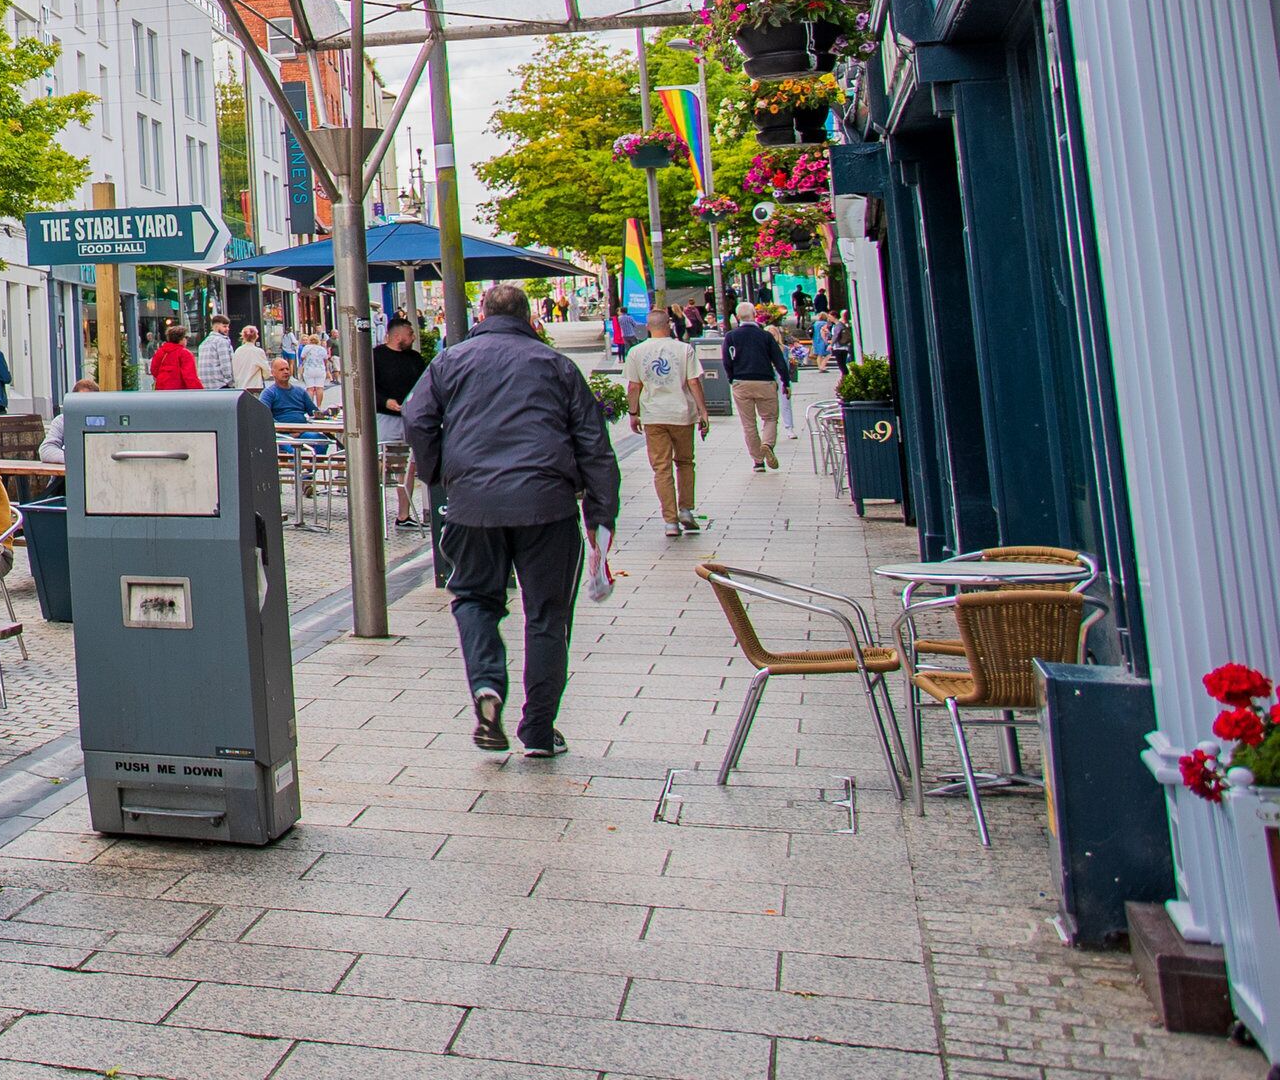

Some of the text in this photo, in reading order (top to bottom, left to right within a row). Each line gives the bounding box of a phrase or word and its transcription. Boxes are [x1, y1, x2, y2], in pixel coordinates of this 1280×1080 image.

[40, 214, 183, 242] THE STABLE YARD.
[81, 243, 144, 254] FOOD HALL
[115, 761, 223, 777] PUSH ME DOWN
